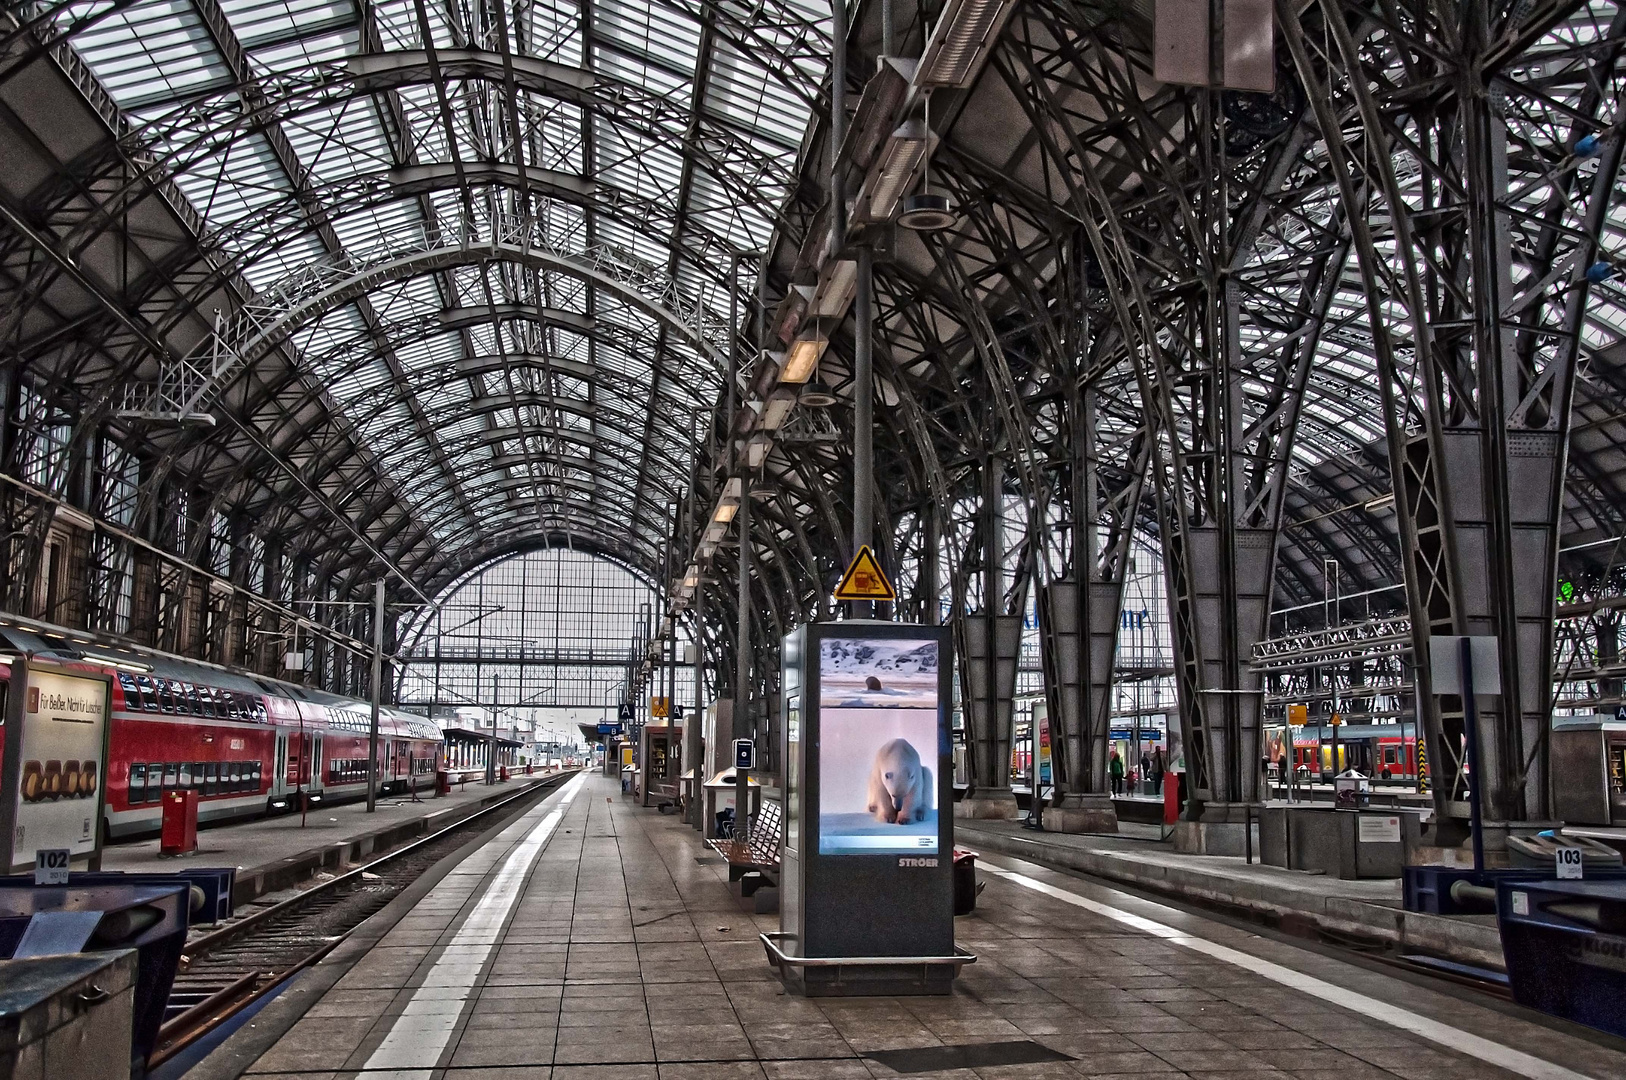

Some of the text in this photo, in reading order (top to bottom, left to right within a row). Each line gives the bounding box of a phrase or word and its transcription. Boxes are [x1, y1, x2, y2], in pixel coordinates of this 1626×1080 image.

[40, 693, 49, 710] Für
[621, 704, 631, 716] A
[1618, 706, 1626, 718] A
[39, 851, 68, 869] 102
[1557, 850, 1581, 865] 103
[49, 871, 68, 879] 2010
